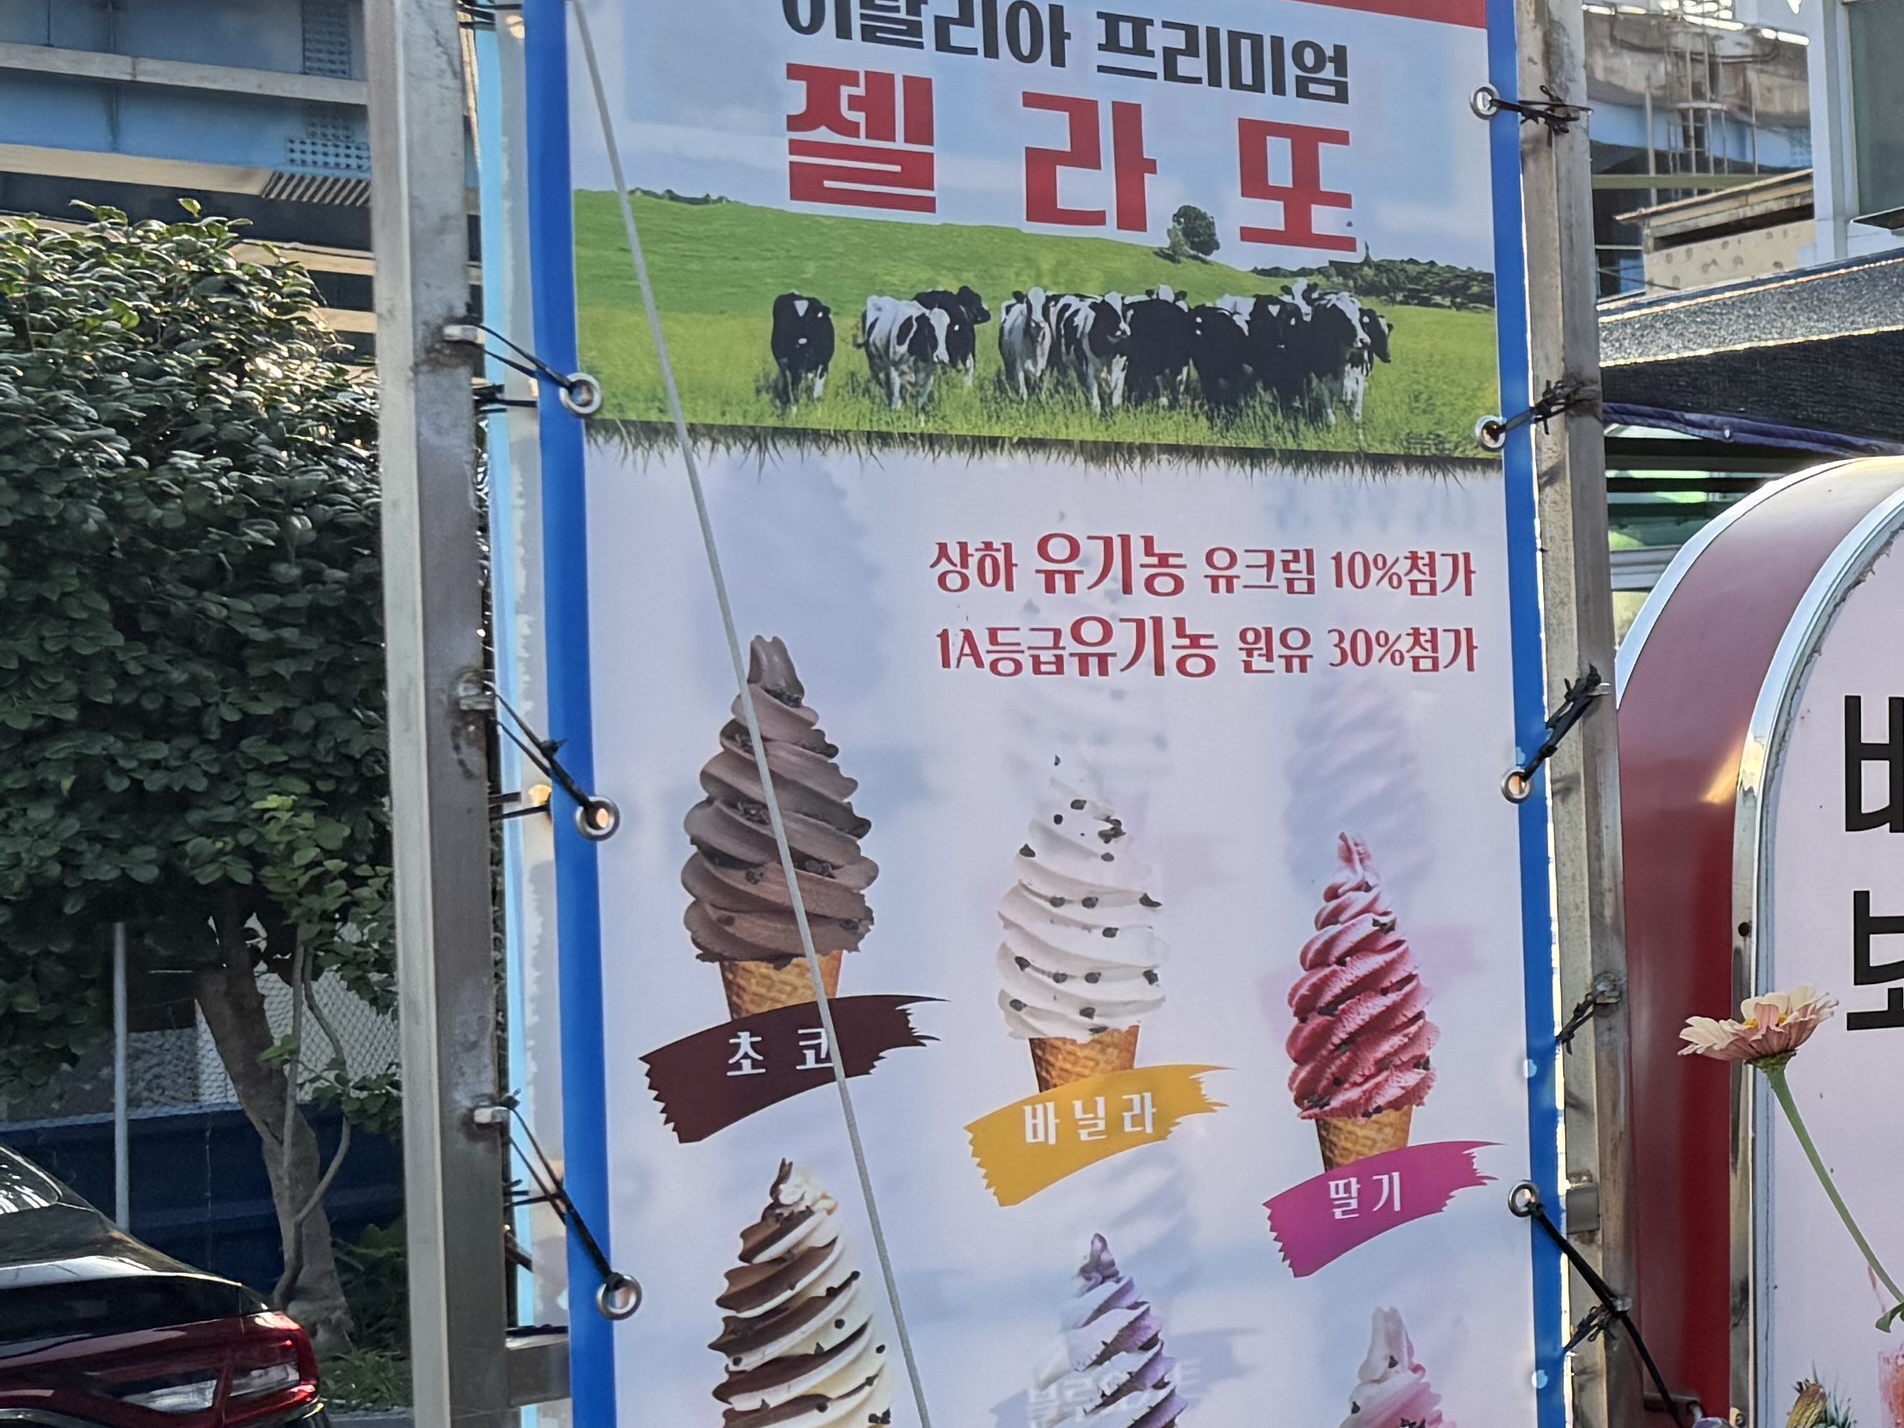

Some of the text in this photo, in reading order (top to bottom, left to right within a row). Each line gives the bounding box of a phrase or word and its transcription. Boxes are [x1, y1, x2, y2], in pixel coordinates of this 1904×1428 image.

[1096, 9, 1351, 107] 프리미엄
[928, 531, 1478, 598] 상하 유기농 유크림 10%첨가
[1237, 624, 1314, 676] 원유
[1327, 625, 1479, 676] 30%첨가
[726, 1025, 841, 1079] 초코
[1022, 1096, 1159, 1147] 바닐라
[1327, 1170, 1403, 1220] 딸기
